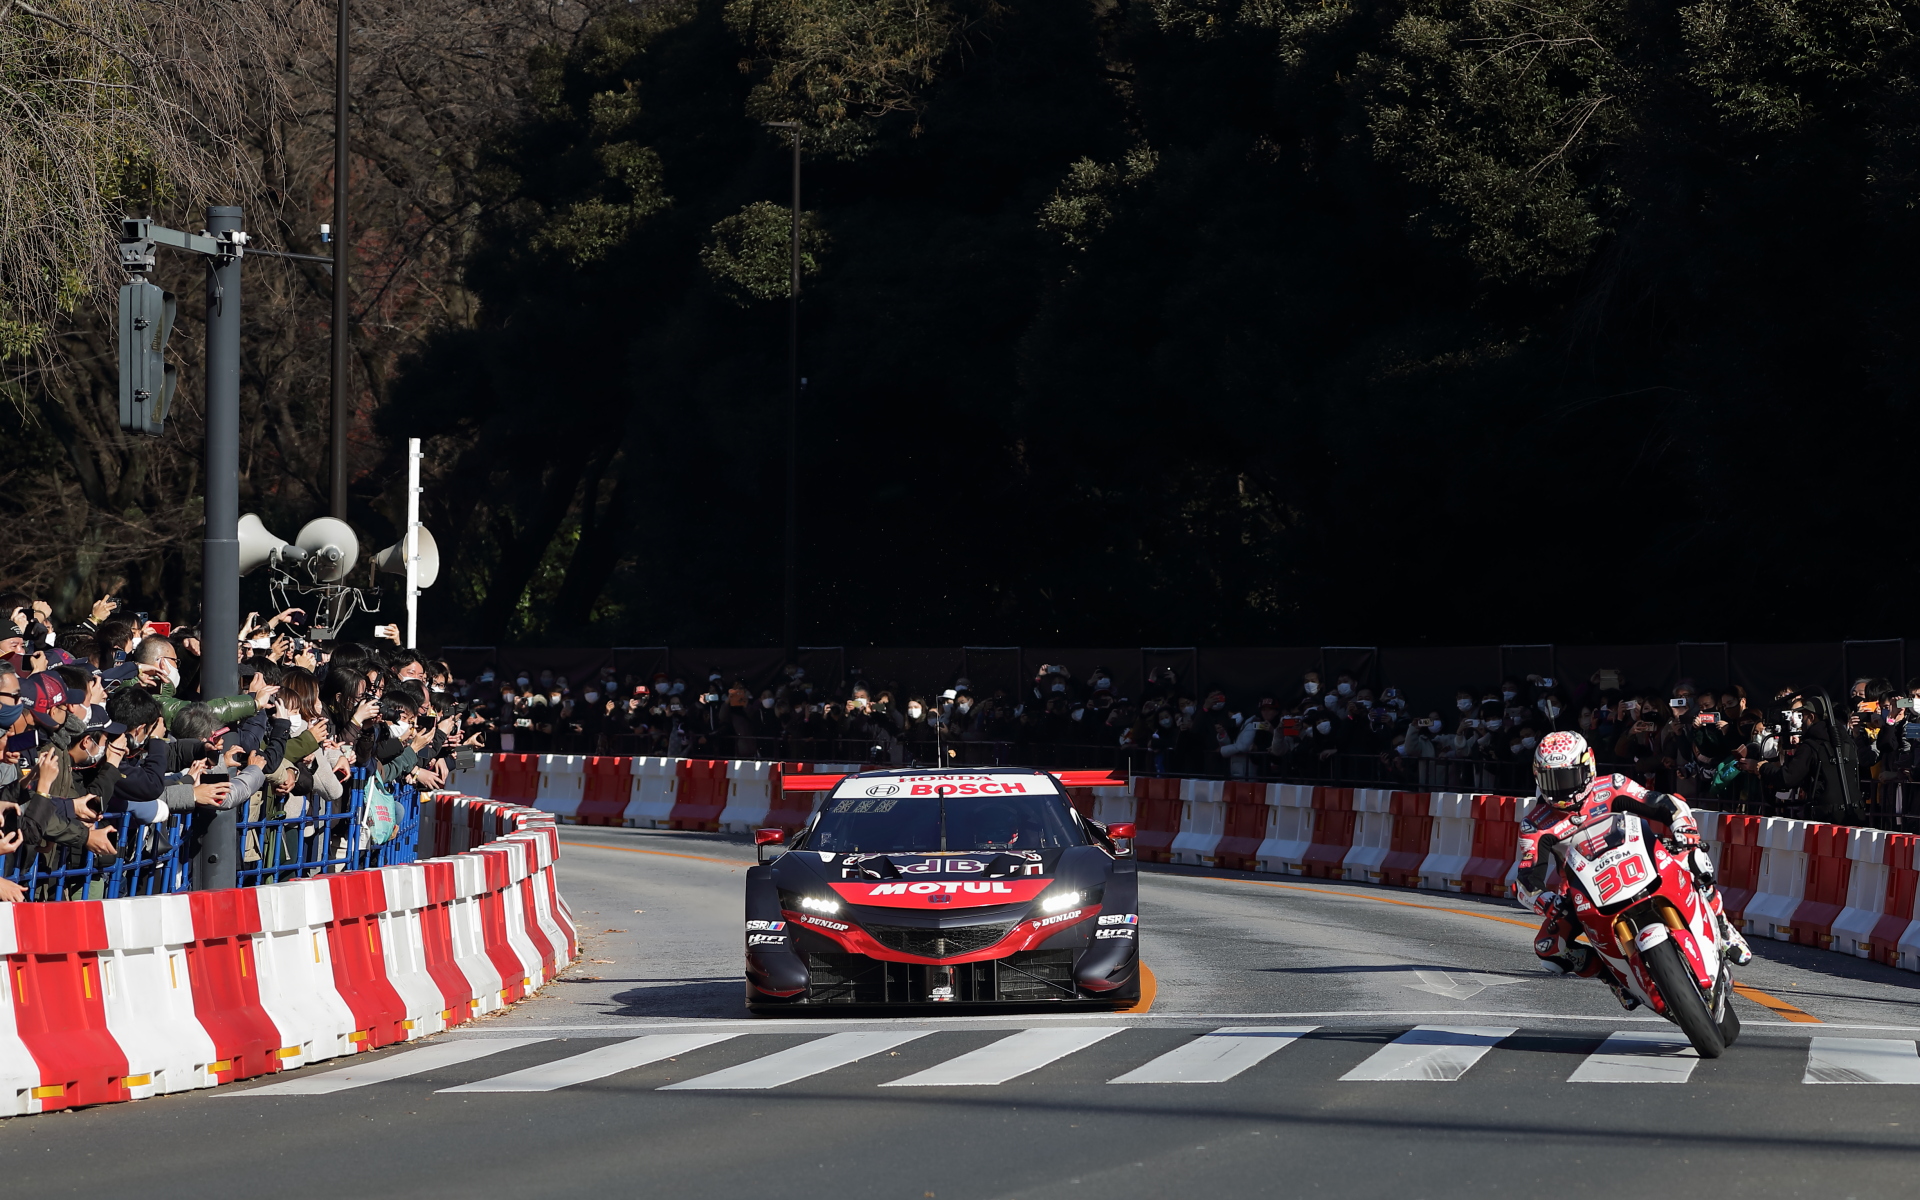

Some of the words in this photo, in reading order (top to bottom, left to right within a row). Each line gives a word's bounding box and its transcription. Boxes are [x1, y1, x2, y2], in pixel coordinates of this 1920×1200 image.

[52, 692, 63, 704] 16
[1545, 753, 1565, 761] Arai
[898, 775, 995, 783] HONDA
[910, 783, 1027, 796] BOSCH
[1592, 853, 1648, 906] 30
[868, 882, 1013, 895] MOTUL
[806, 916, 849, 931] DUNLOP
[1041, 910, 1082, 926] DUNLOP
[1098, 914, 1124, 925] SSR
[746, 920, 769, 931] SSR
